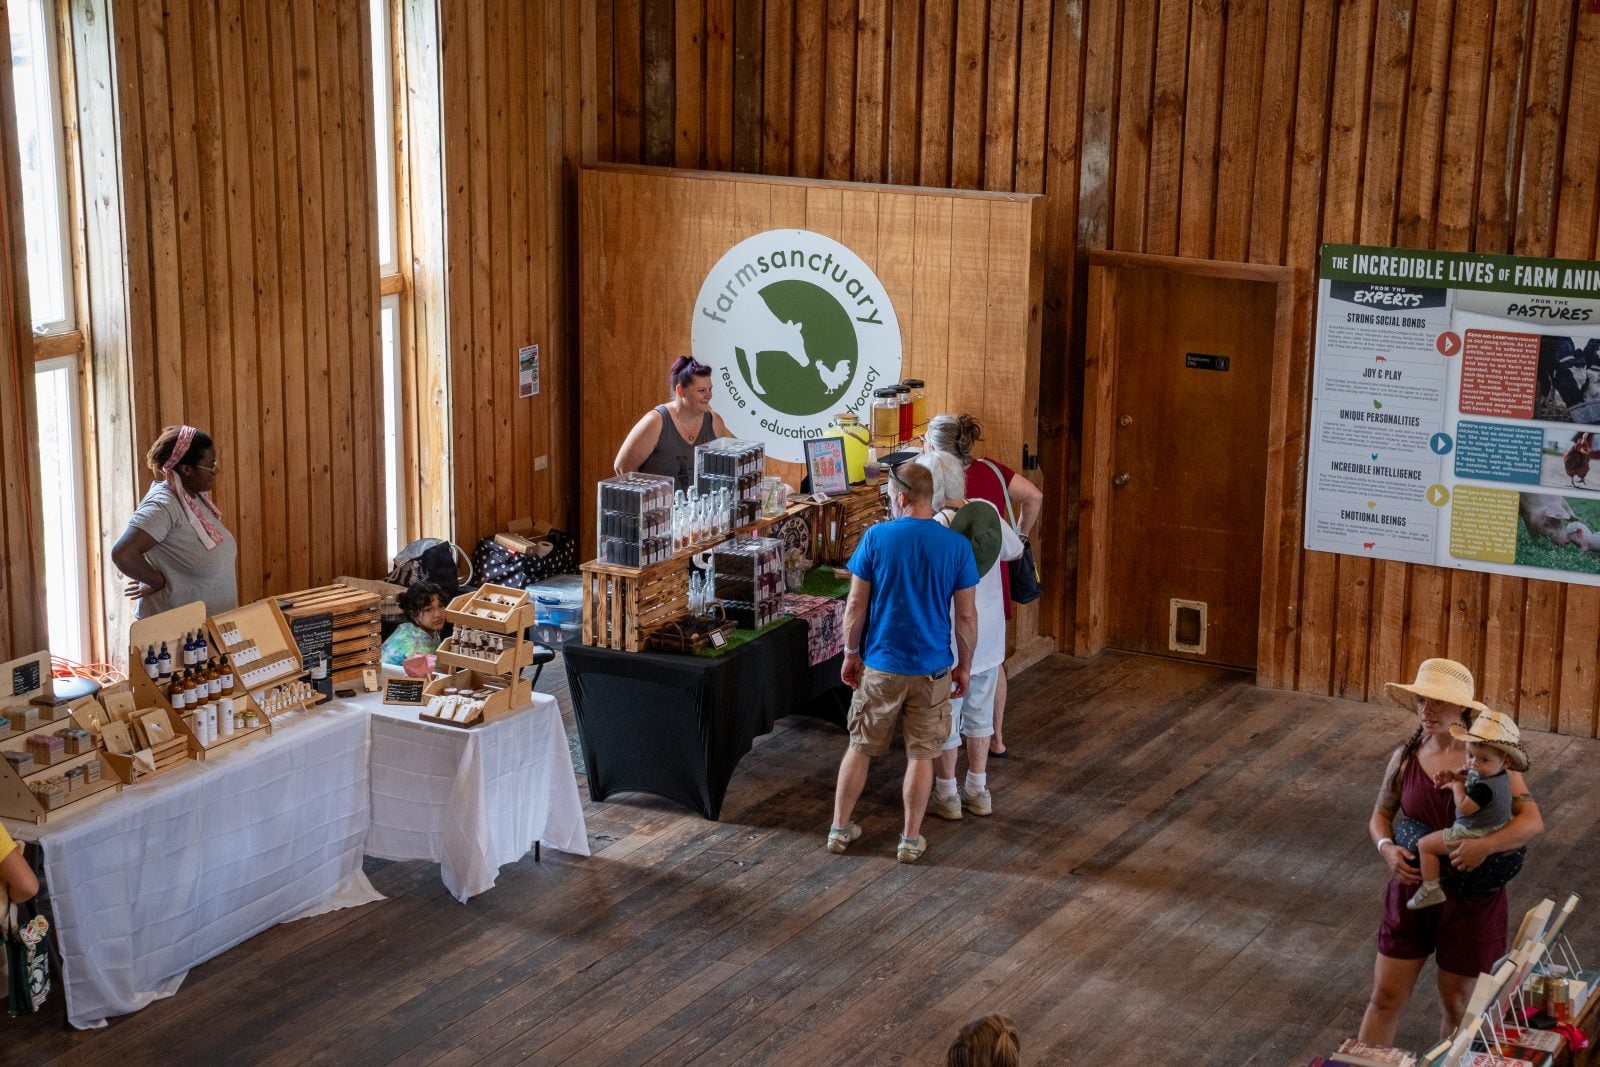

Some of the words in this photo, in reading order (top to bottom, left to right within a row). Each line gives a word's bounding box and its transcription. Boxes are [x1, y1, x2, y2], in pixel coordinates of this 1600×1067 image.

[1332, 256, 1348, 270] THE
[1352, 254, 1443, 280] INCREDIBLE
[1449, 262, 1494, 284] LIVES
[1498, 269, 1510, 281] OF
[1514, 266, 1558, 289] FARM
[1354, 290, 1424, 307] EXPERTS
[1347, 313, 1374, 325] STRONG
[1375, 315, 1400, 327] SOCIAL
[1402, 317, 1426, 329] BONDS
[1507, 303, 1593, 321] PASTURES
[1363, 367, 1376, 378] JOY
[1384, 370, 1402, 381] PLAY
[720, 366, 746, 409] rescue
[846, 366, 881, 414] dvocacy
[1340, 409, 1364, 422] UNIQUE
[1366, 412, 1420, 427] PERSONALITIES
[760, 417, 823, 439] education
[1331, 460, 1371, 475] INCREDIBLE
[1373, 465, 1422, 481] INTELLIGENCE
[1341, 510, 1379, 524] EMOTIONAL
[1381, 514, 1406, 527] BEINGS
